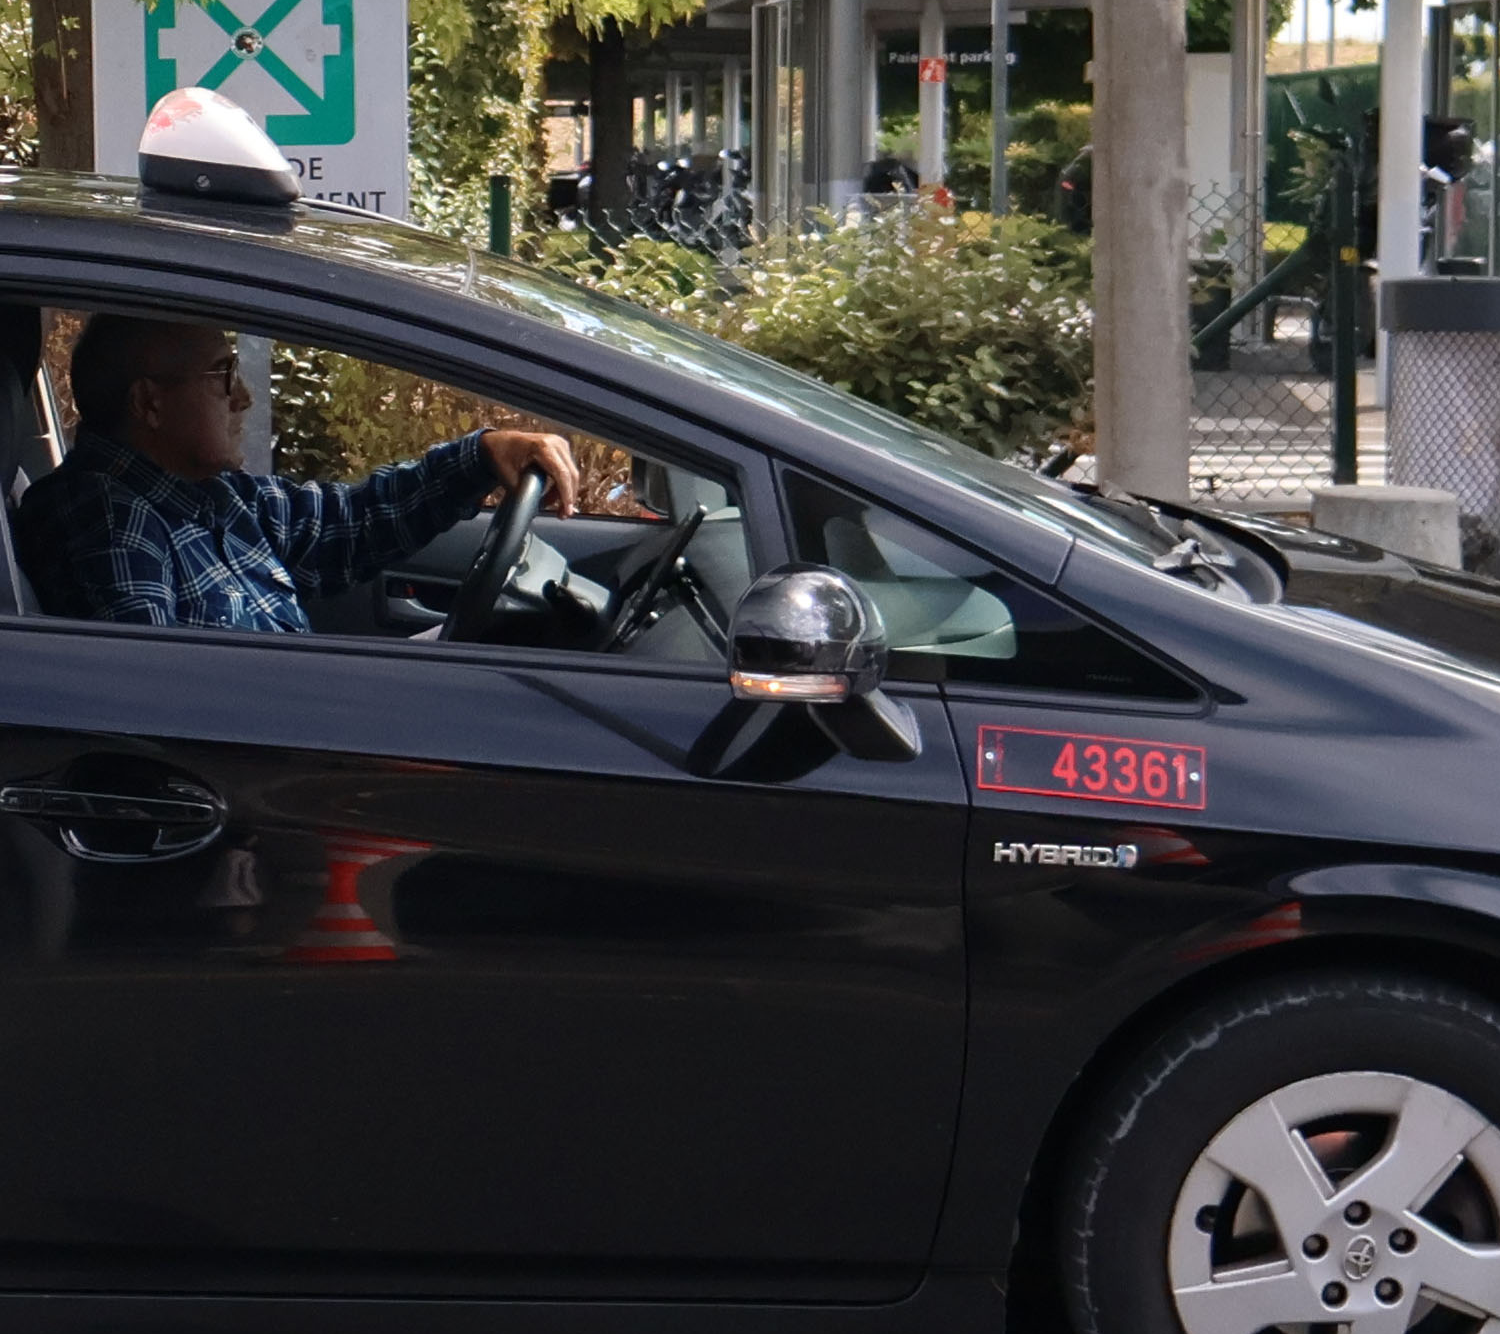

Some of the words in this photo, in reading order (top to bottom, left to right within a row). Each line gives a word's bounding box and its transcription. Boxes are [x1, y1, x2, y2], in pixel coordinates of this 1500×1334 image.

[960, 50, 1016, 67] parkg
[1051, 742, 1188, 800] 43361
[993, 841, 1116, 867] HYBRID
